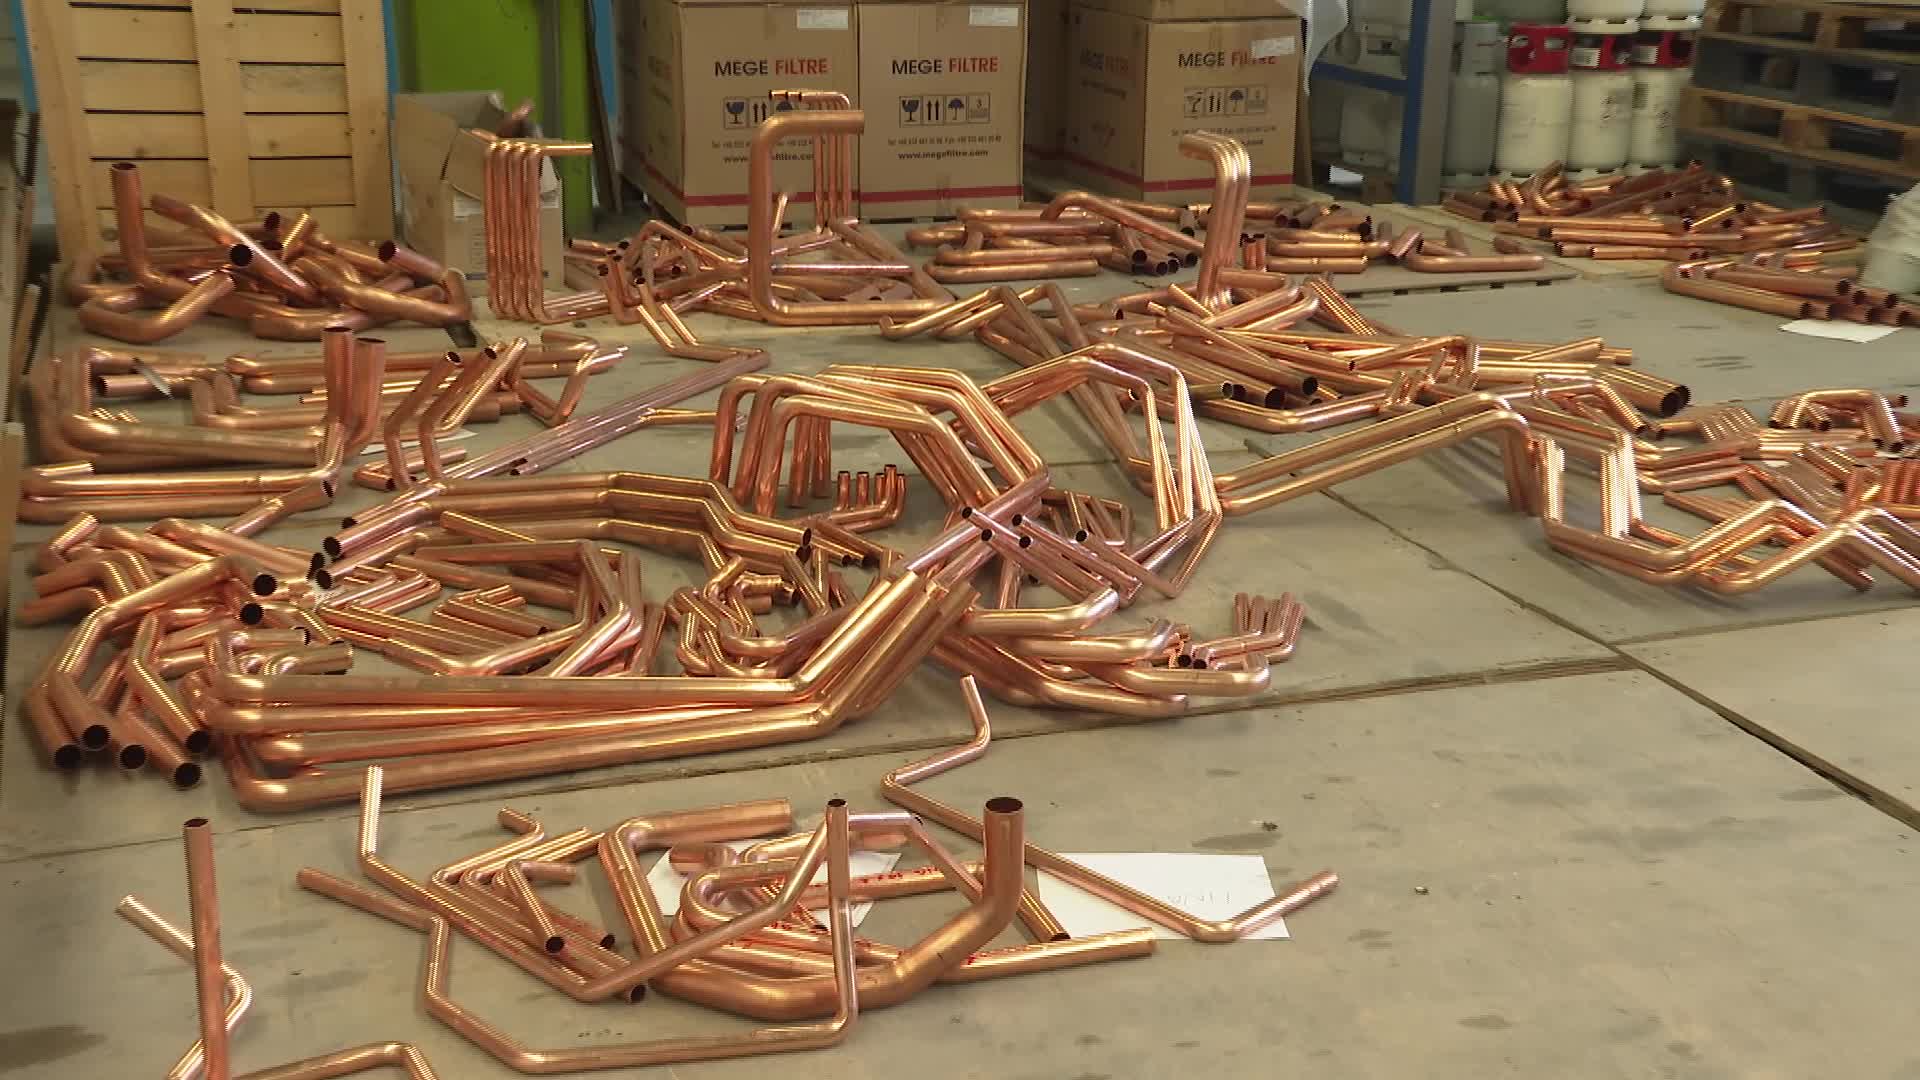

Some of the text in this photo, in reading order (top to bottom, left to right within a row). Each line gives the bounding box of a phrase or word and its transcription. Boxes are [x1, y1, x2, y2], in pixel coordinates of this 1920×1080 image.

[714, 57, 828, 76] MEGE FILTRE
[892, 57, 998, 74] MEGE FILTRE
[1178, 51, 1225, 68] MEGE
